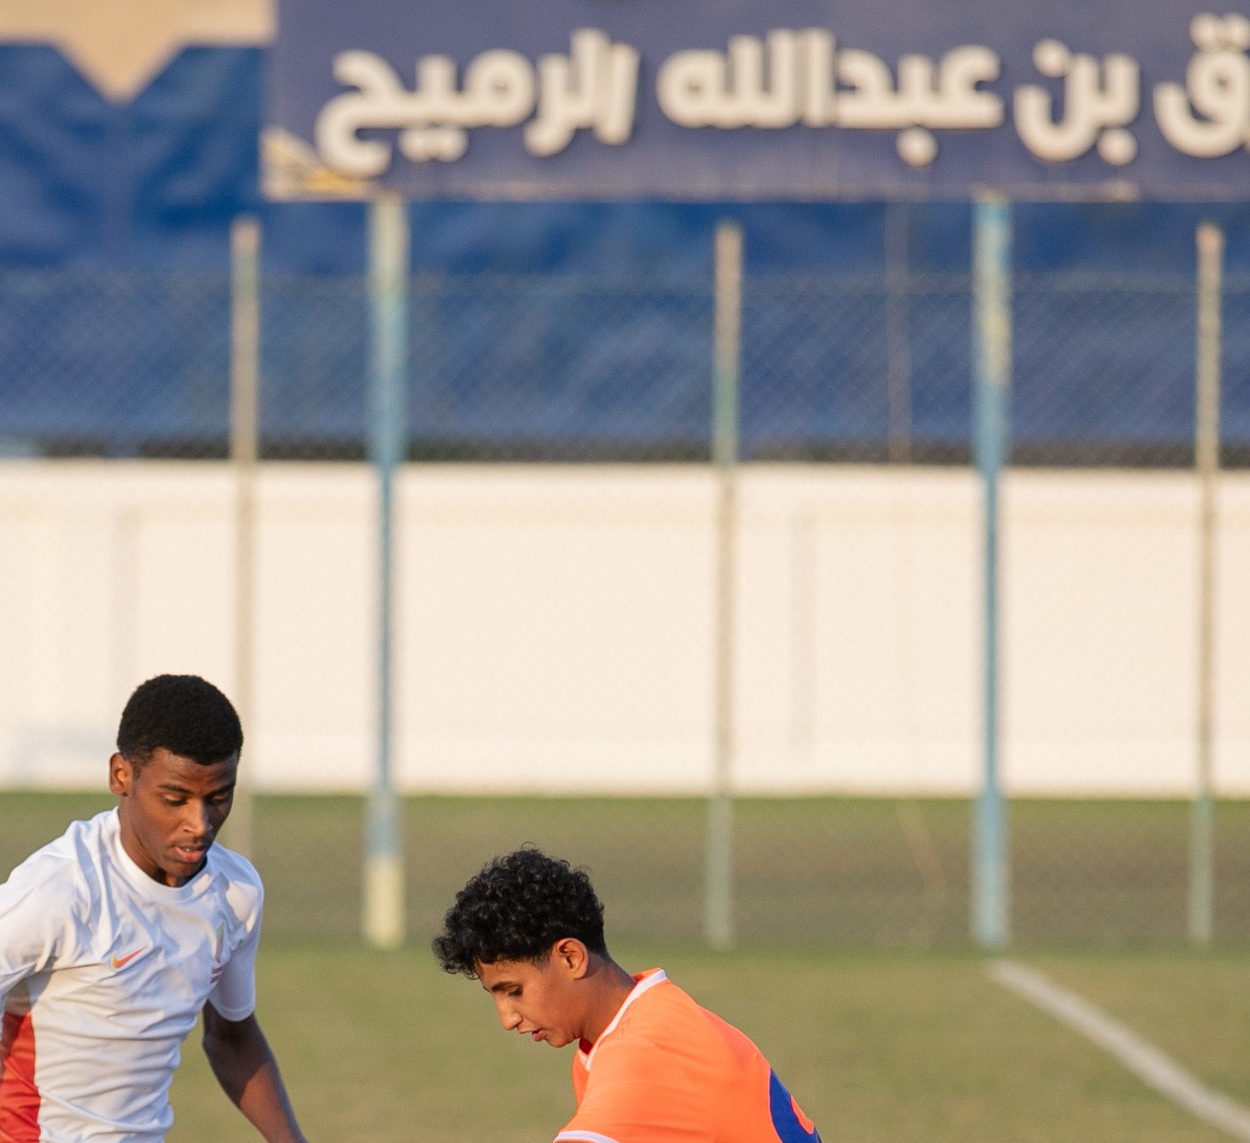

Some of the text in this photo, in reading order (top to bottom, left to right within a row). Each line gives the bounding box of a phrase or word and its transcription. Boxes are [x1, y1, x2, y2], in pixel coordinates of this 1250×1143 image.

[314, 11, 1250, 178] ق بن عبدالله الرميح
